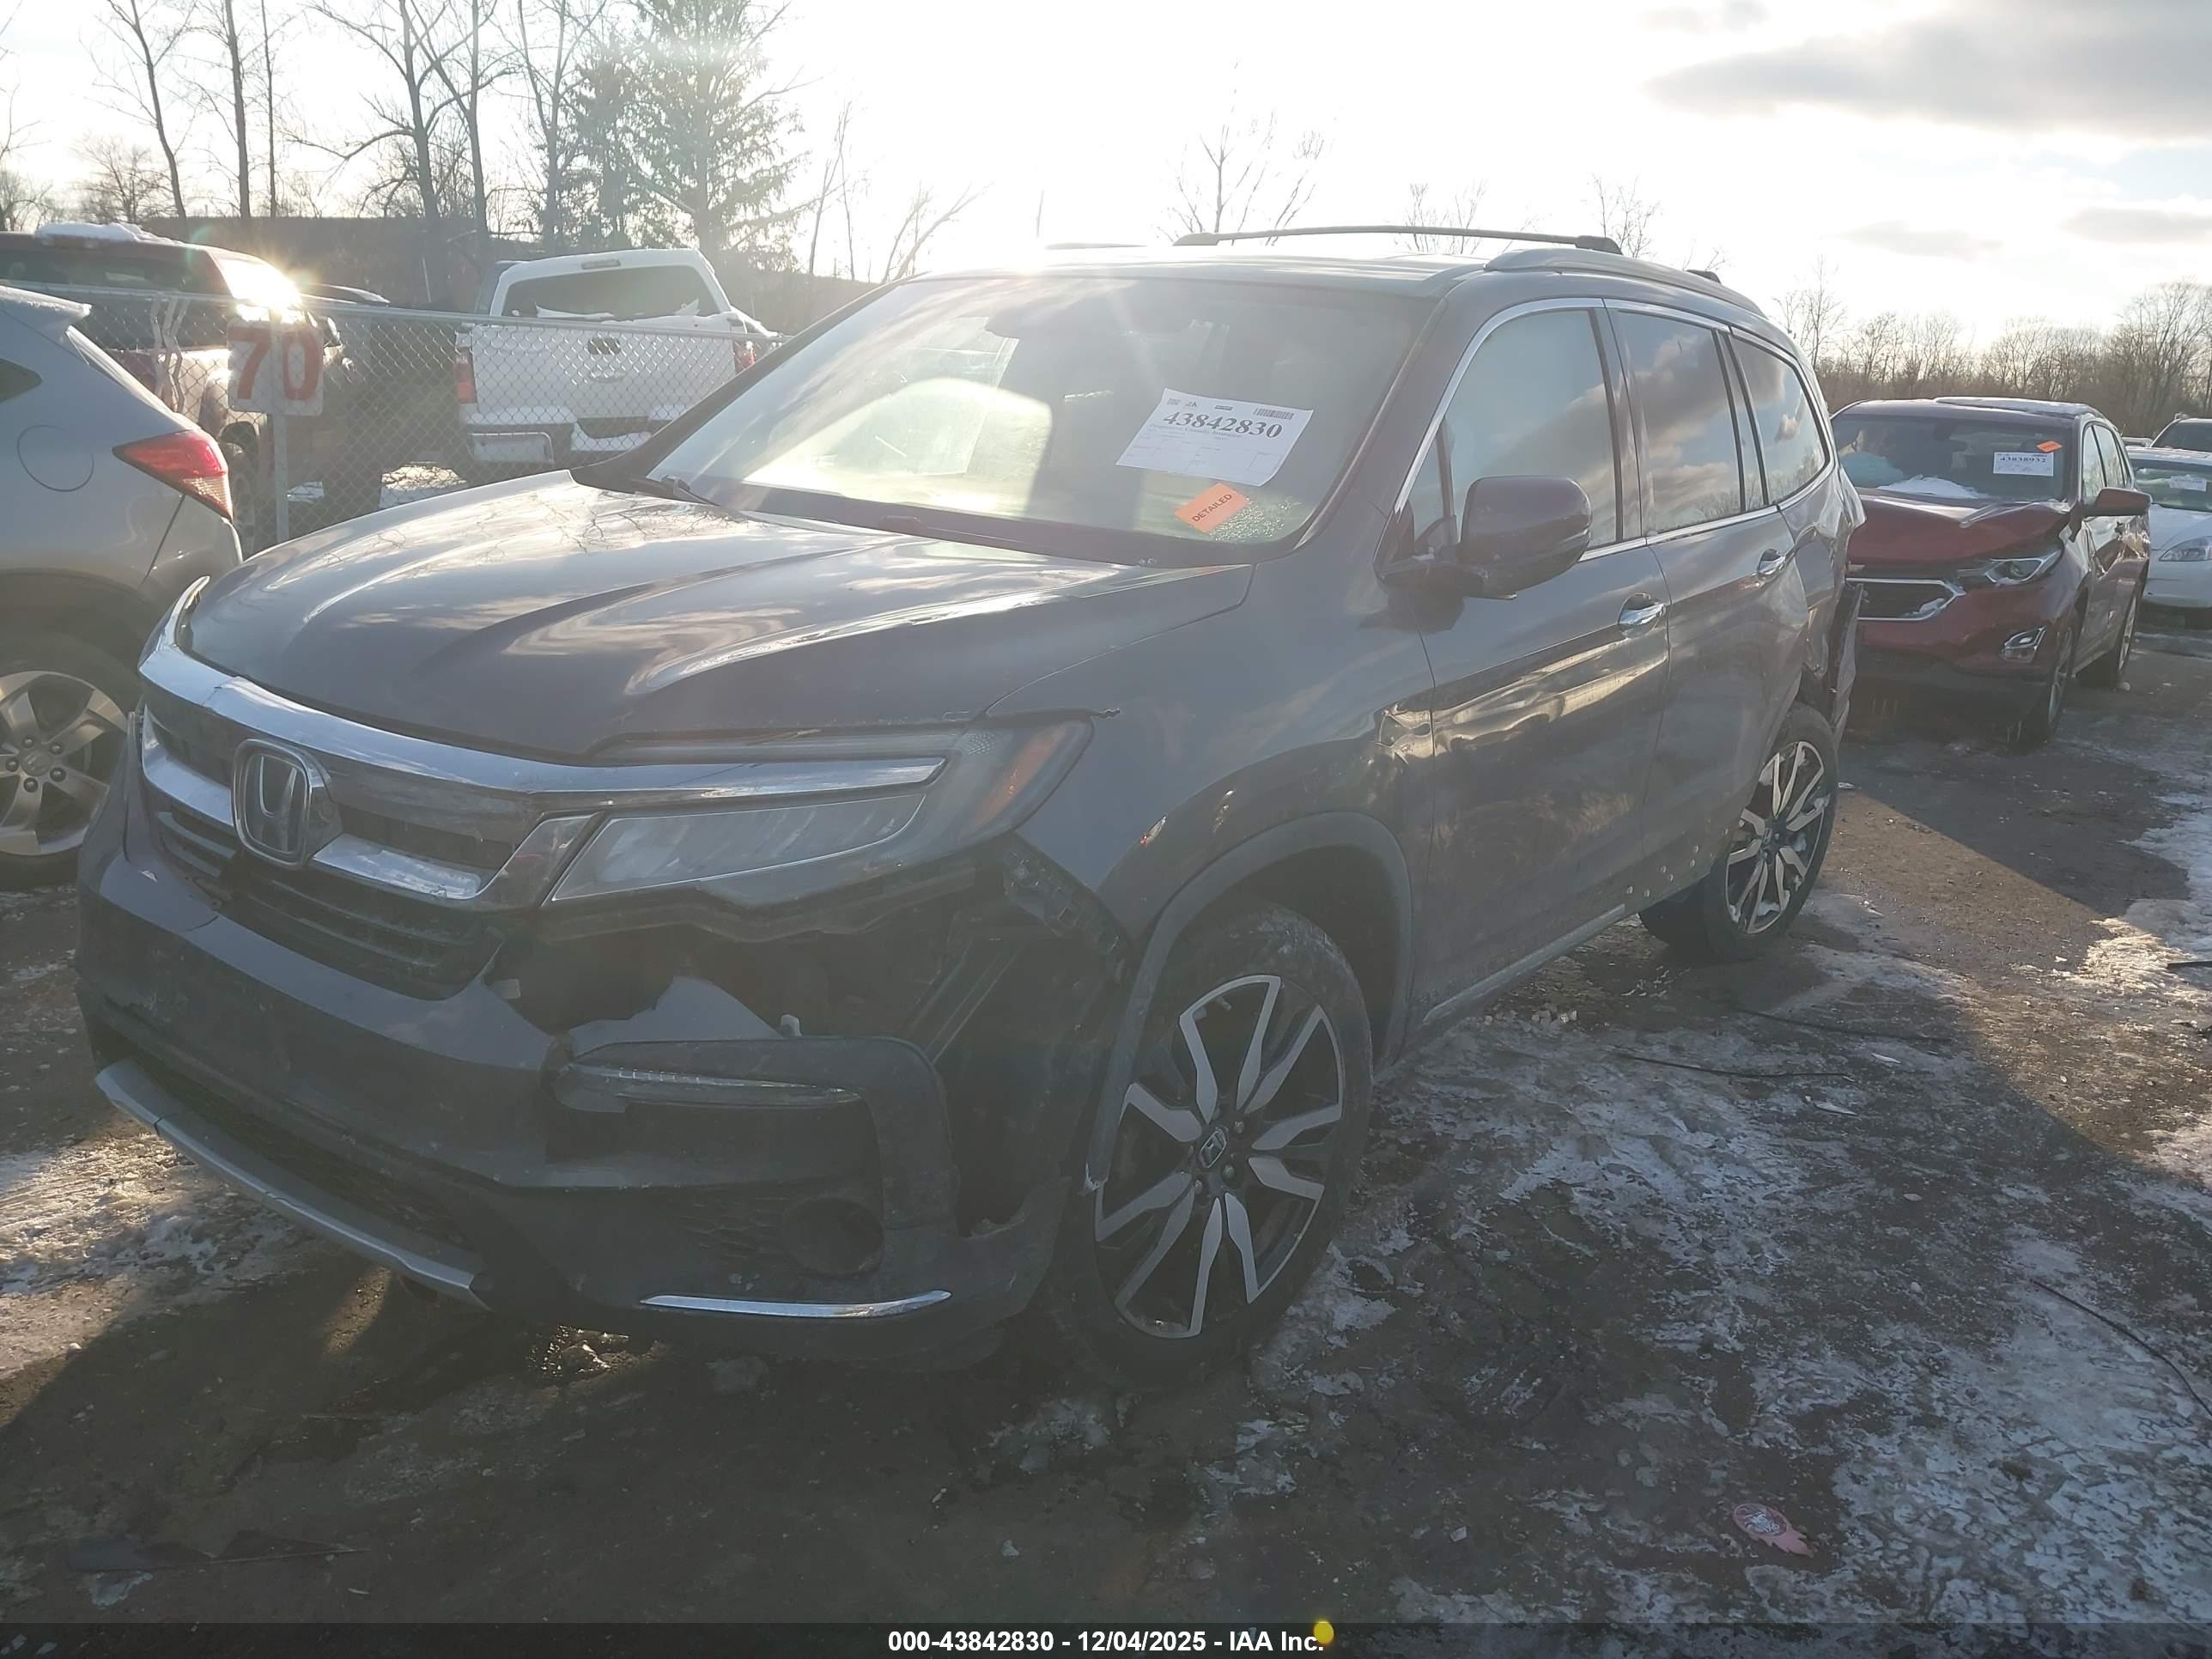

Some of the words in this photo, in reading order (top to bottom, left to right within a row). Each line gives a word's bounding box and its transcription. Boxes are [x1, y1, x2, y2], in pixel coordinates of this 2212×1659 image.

[229, 329, 319, 400] 70
[1164, 411, 1283, 438] 43842830
[1191, 493, 1233, 522] DETAILED
